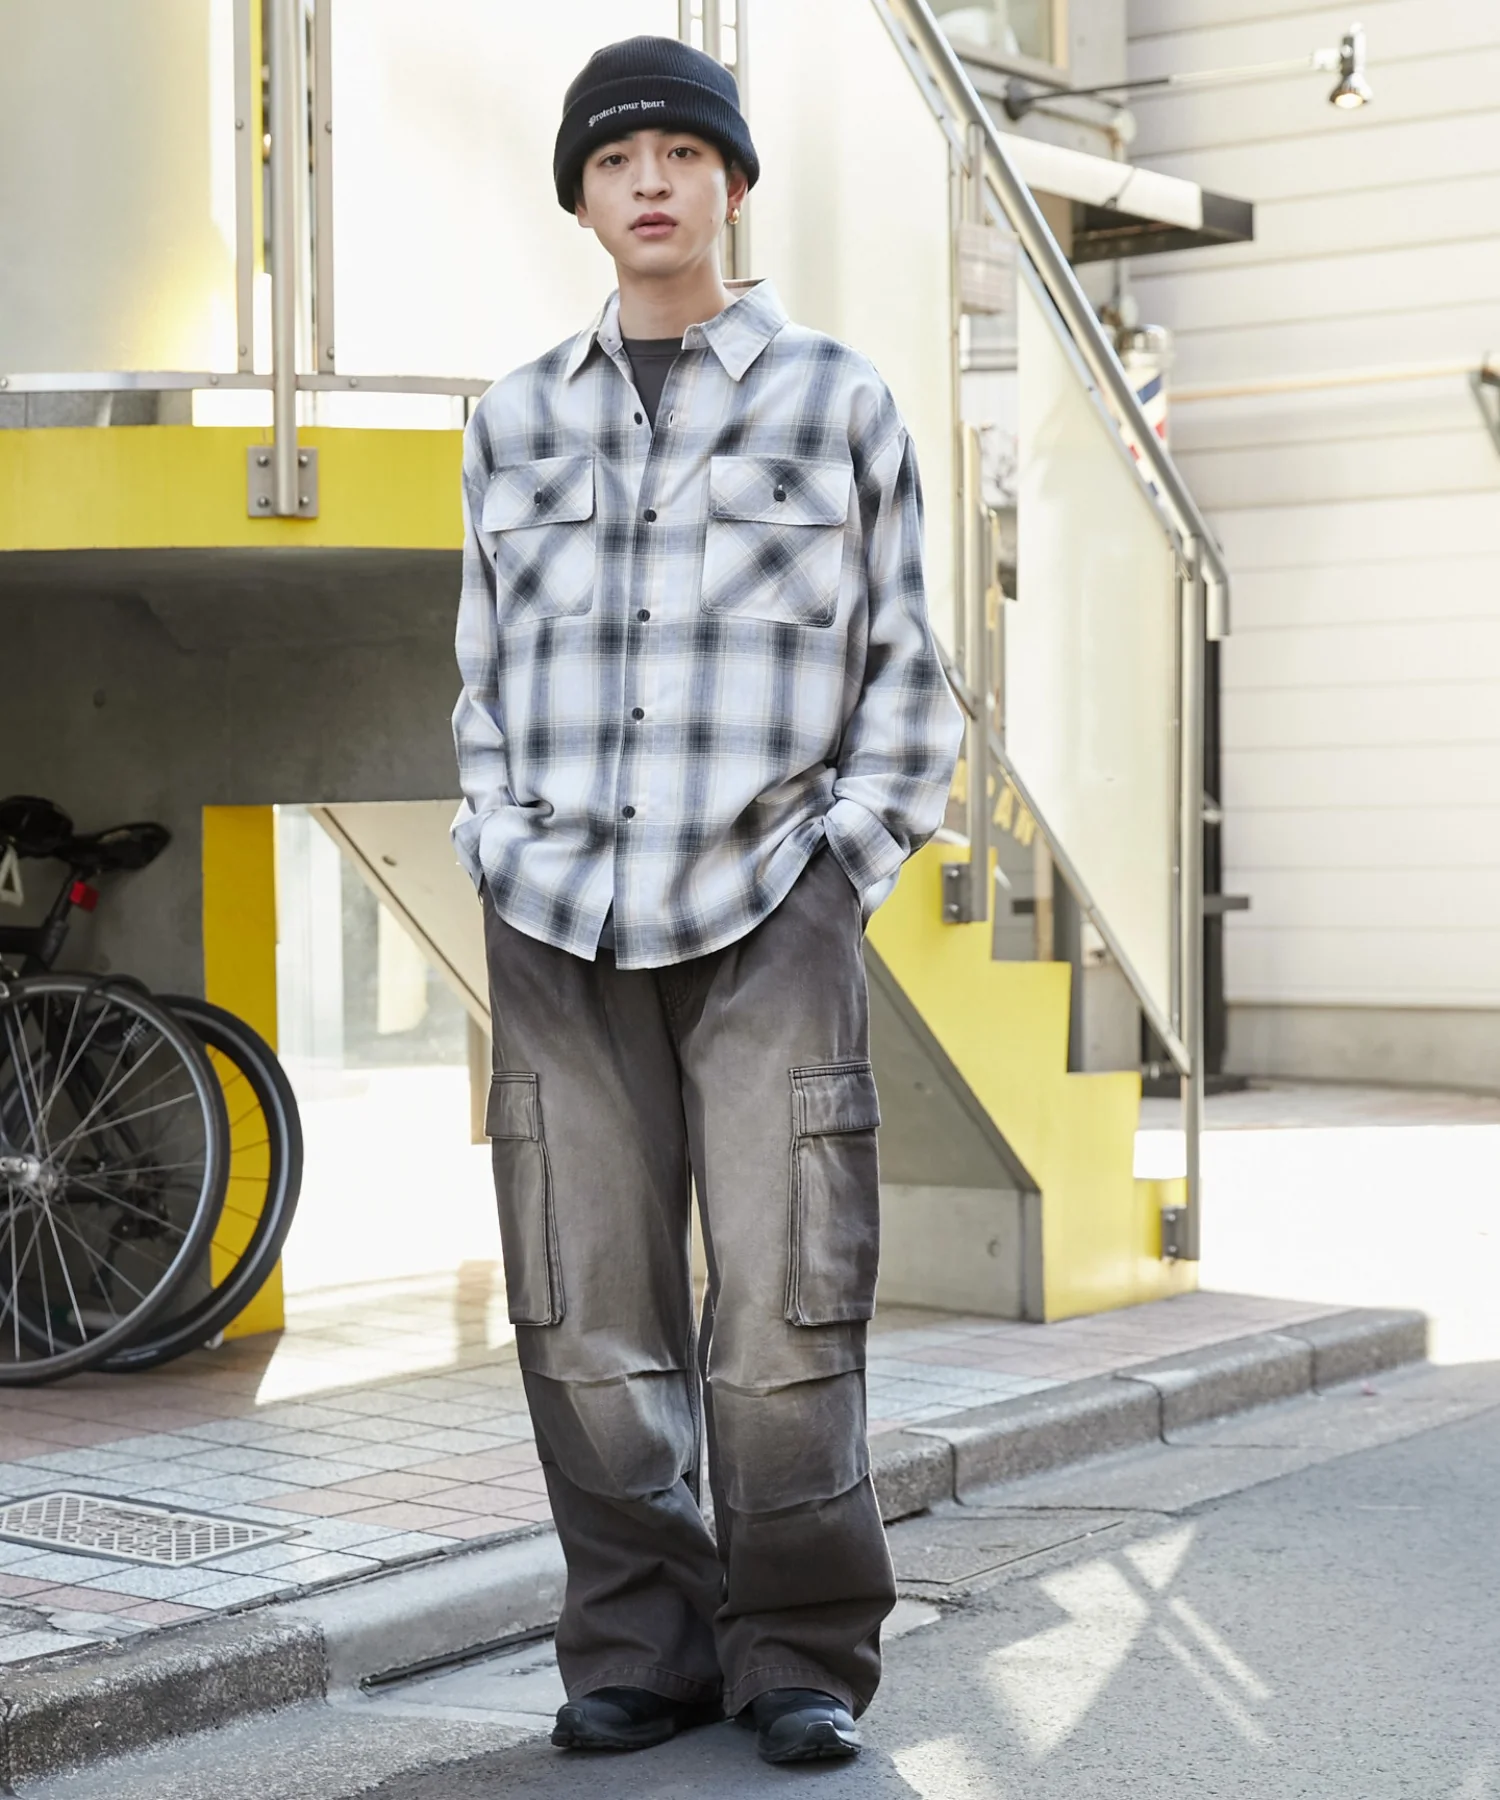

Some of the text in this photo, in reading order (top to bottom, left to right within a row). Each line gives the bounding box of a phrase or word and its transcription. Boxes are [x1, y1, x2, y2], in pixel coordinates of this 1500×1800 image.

[588, 99, 665, 127] Protect your heart
